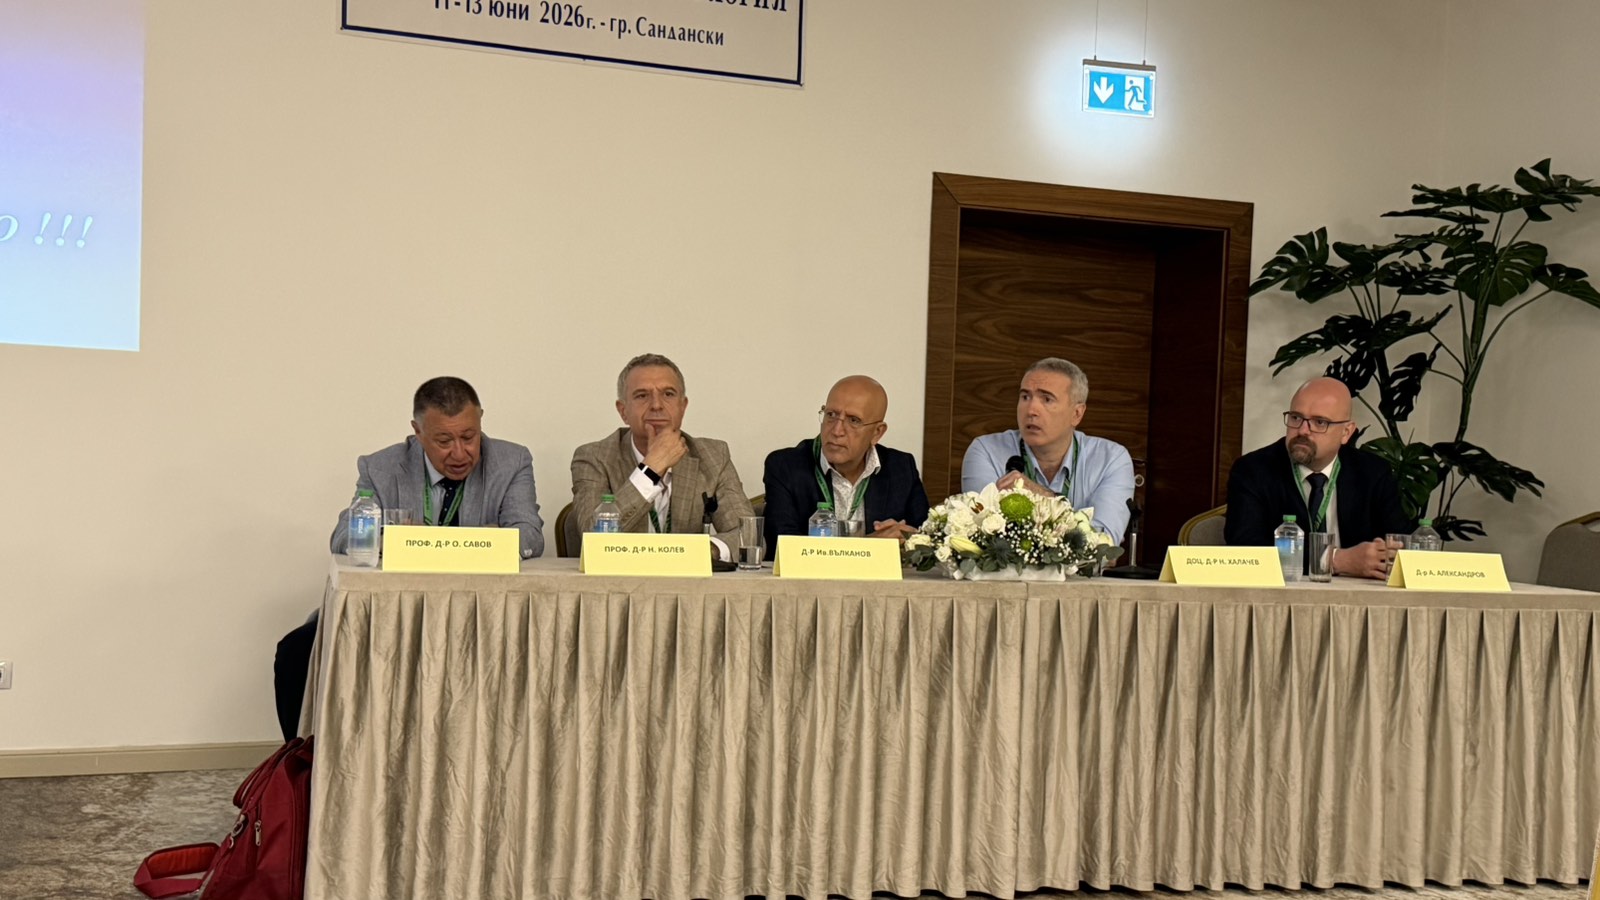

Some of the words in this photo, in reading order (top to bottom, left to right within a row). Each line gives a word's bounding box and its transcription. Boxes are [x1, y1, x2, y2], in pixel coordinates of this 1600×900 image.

[488, 0, 530, 21] юни
[609, 17, 632, 40] гр.
[635, 16, 725, 46] Сандански
[405, 539, 433, 548] ПРОФ.
[435, 540, 450, 549] Д-Р
[463, 540, 492, 548] САВОВ
[604, 545, 631, 553] ПРОФ.
[632, 546, 647, 554] Д-Р
[658, 546, 685, 554] КОЛЕВ
[1227, 558, 1260, 566] ХАЛАЧЕВ
